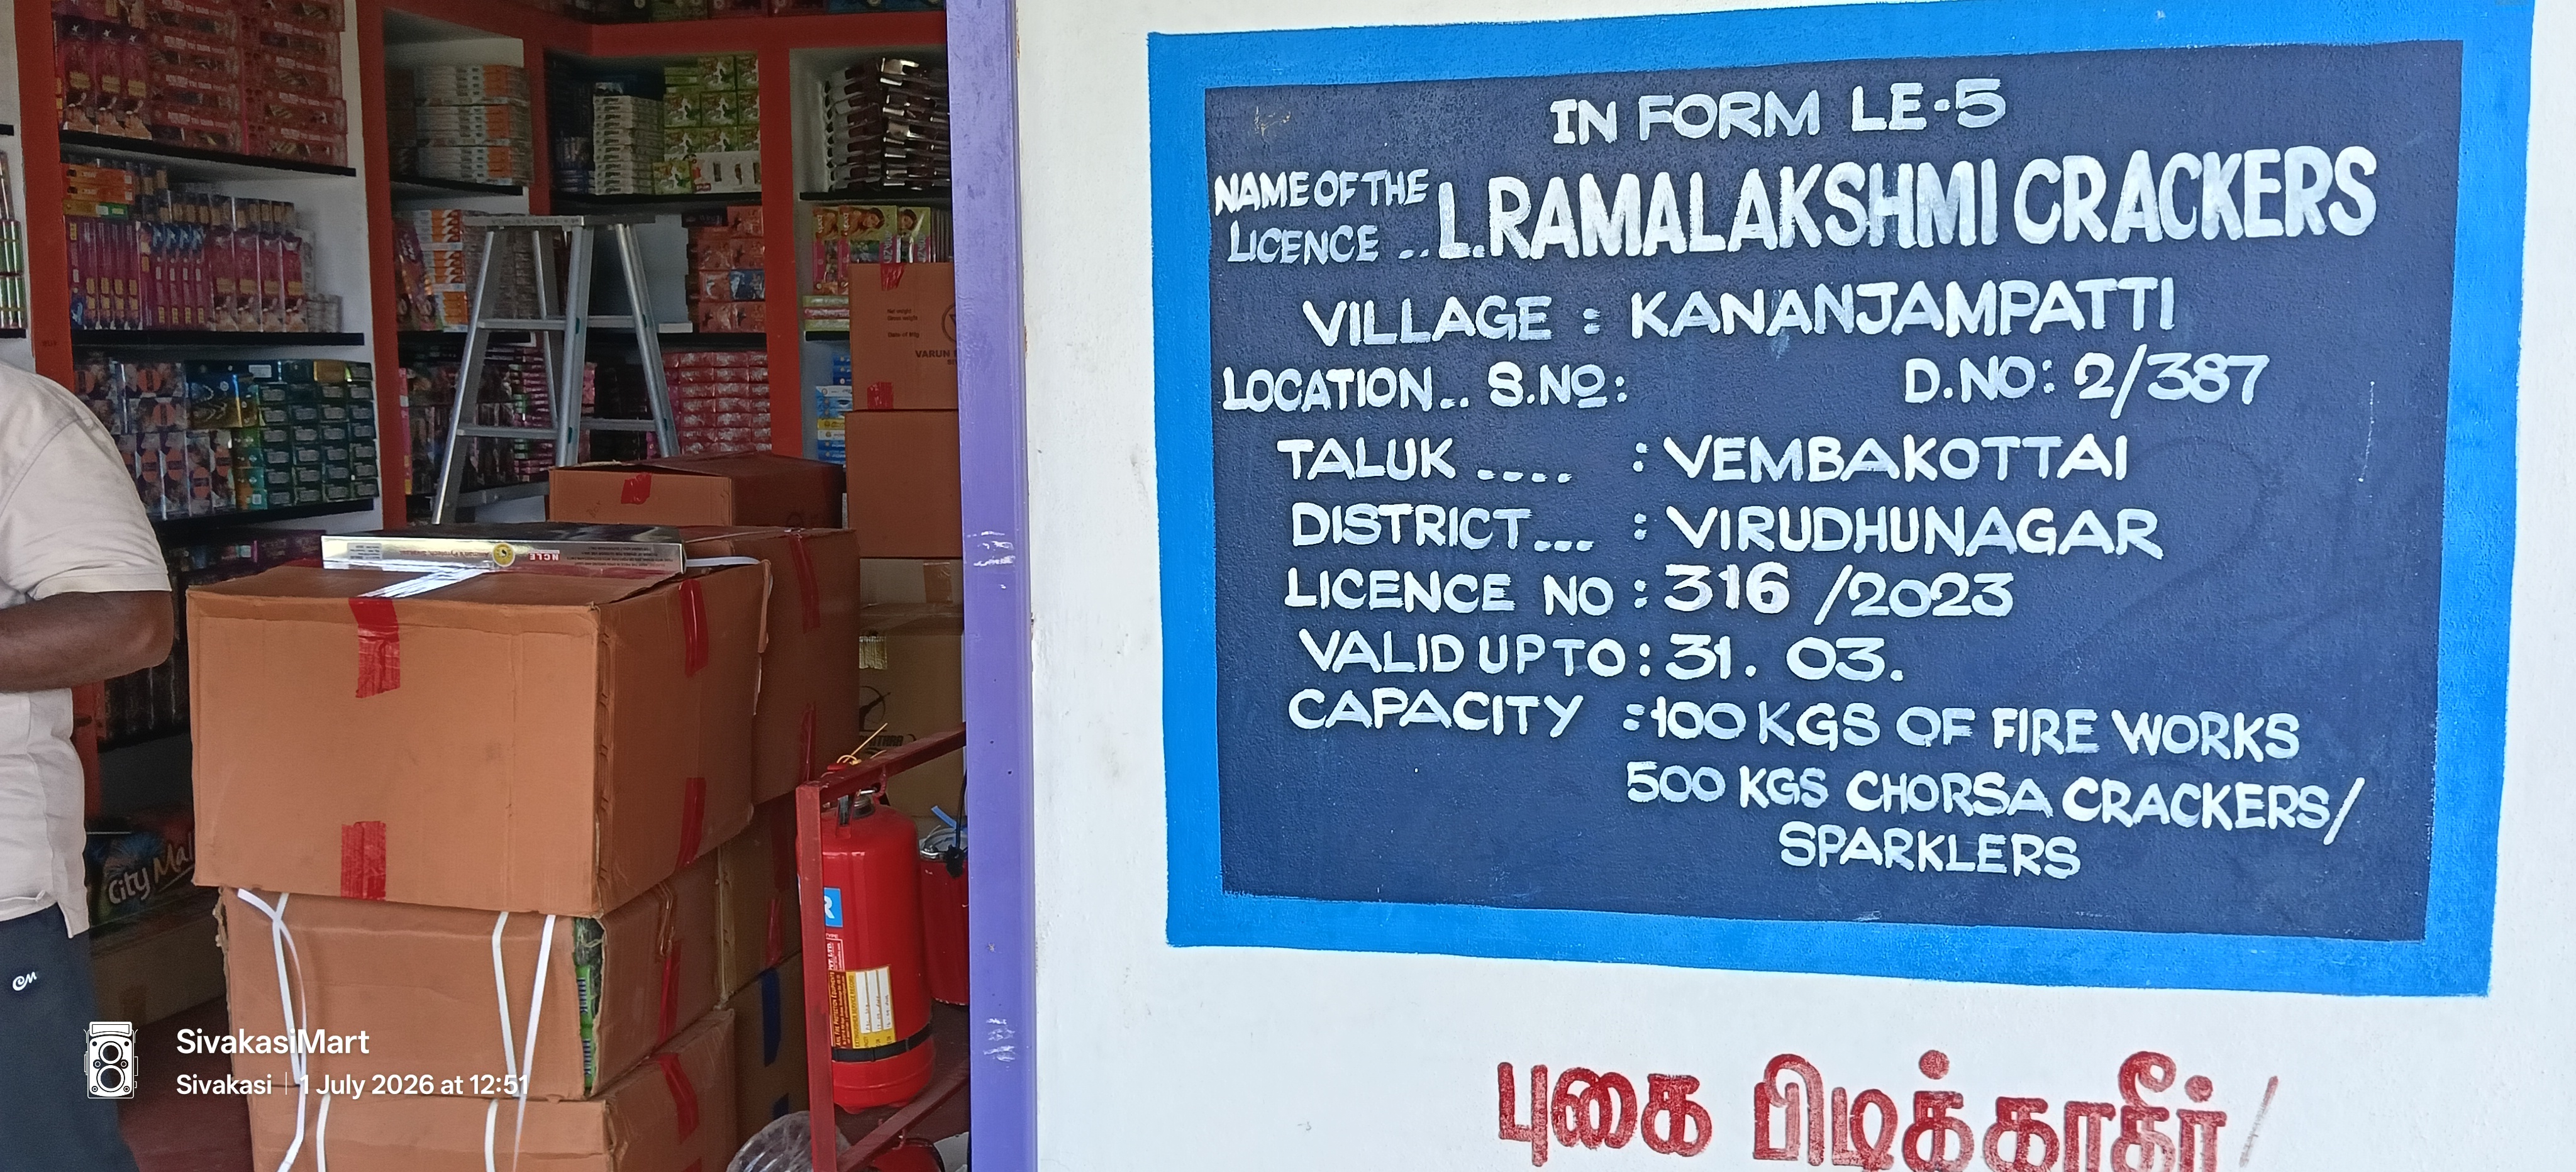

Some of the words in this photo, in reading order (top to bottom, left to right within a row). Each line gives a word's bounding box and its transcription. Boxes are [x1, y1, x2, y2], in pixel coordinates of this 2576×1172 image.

[1550, 99, 1618, 145] IN
[1638, 89, 1820, 141] FORM
[1214, 170, 1309, 216] NAME
[1314, 170, 1359, 207] OF
[1361, 169, 1429, 206] THE
[1438, 158, 1999, 260] L.RAMALAKSHMI
[2013, 145, 2377, 245] CRACKERS
[1228, 220, 1379, 265] LICENCE
[1302, 295, 1553, 347] VILLAGE
[1631, 277, 2175, 339] KANANJAMPATTI
[915, 350, 950, 358] VARUN
[2074, 343, 2270, 419] 2/387
[1277, 437, 1456, 481] TALUK
[1663, 433, 2128, 483] VEMBAKOTTAI
[1666, 506, 2163, 560] VIRUDHUNAGAR
[1284, 567, 1515, 614] LICENCE
[1543, 574, 1614, 616] NO
[1664, 561, 1790, 614] 316
[1814, 564, 2014, 626] /2023
[1299, 628, 1465, 673] VALID
[1289, 687, 1584, 738] CAPACITY
[1758, 700, 1880, 751] KGS
[1896, 706, 1975, 747] OF
[1991, 707, 2099, 756] FIRE
[2111, 709, 2301, 763] WORKS
[1626, 761, 1726, 803] 500
[1739, 765, 1829, 809] KGS
[1846, 770, 2054, 819] CHORSA
[108, 866, 151, 904] City
[153, 831, 194, 884] Mal
[1779, 821, 2081, 879] SPARKLERS
[1497, 1061, 1714, 1168] புகை
